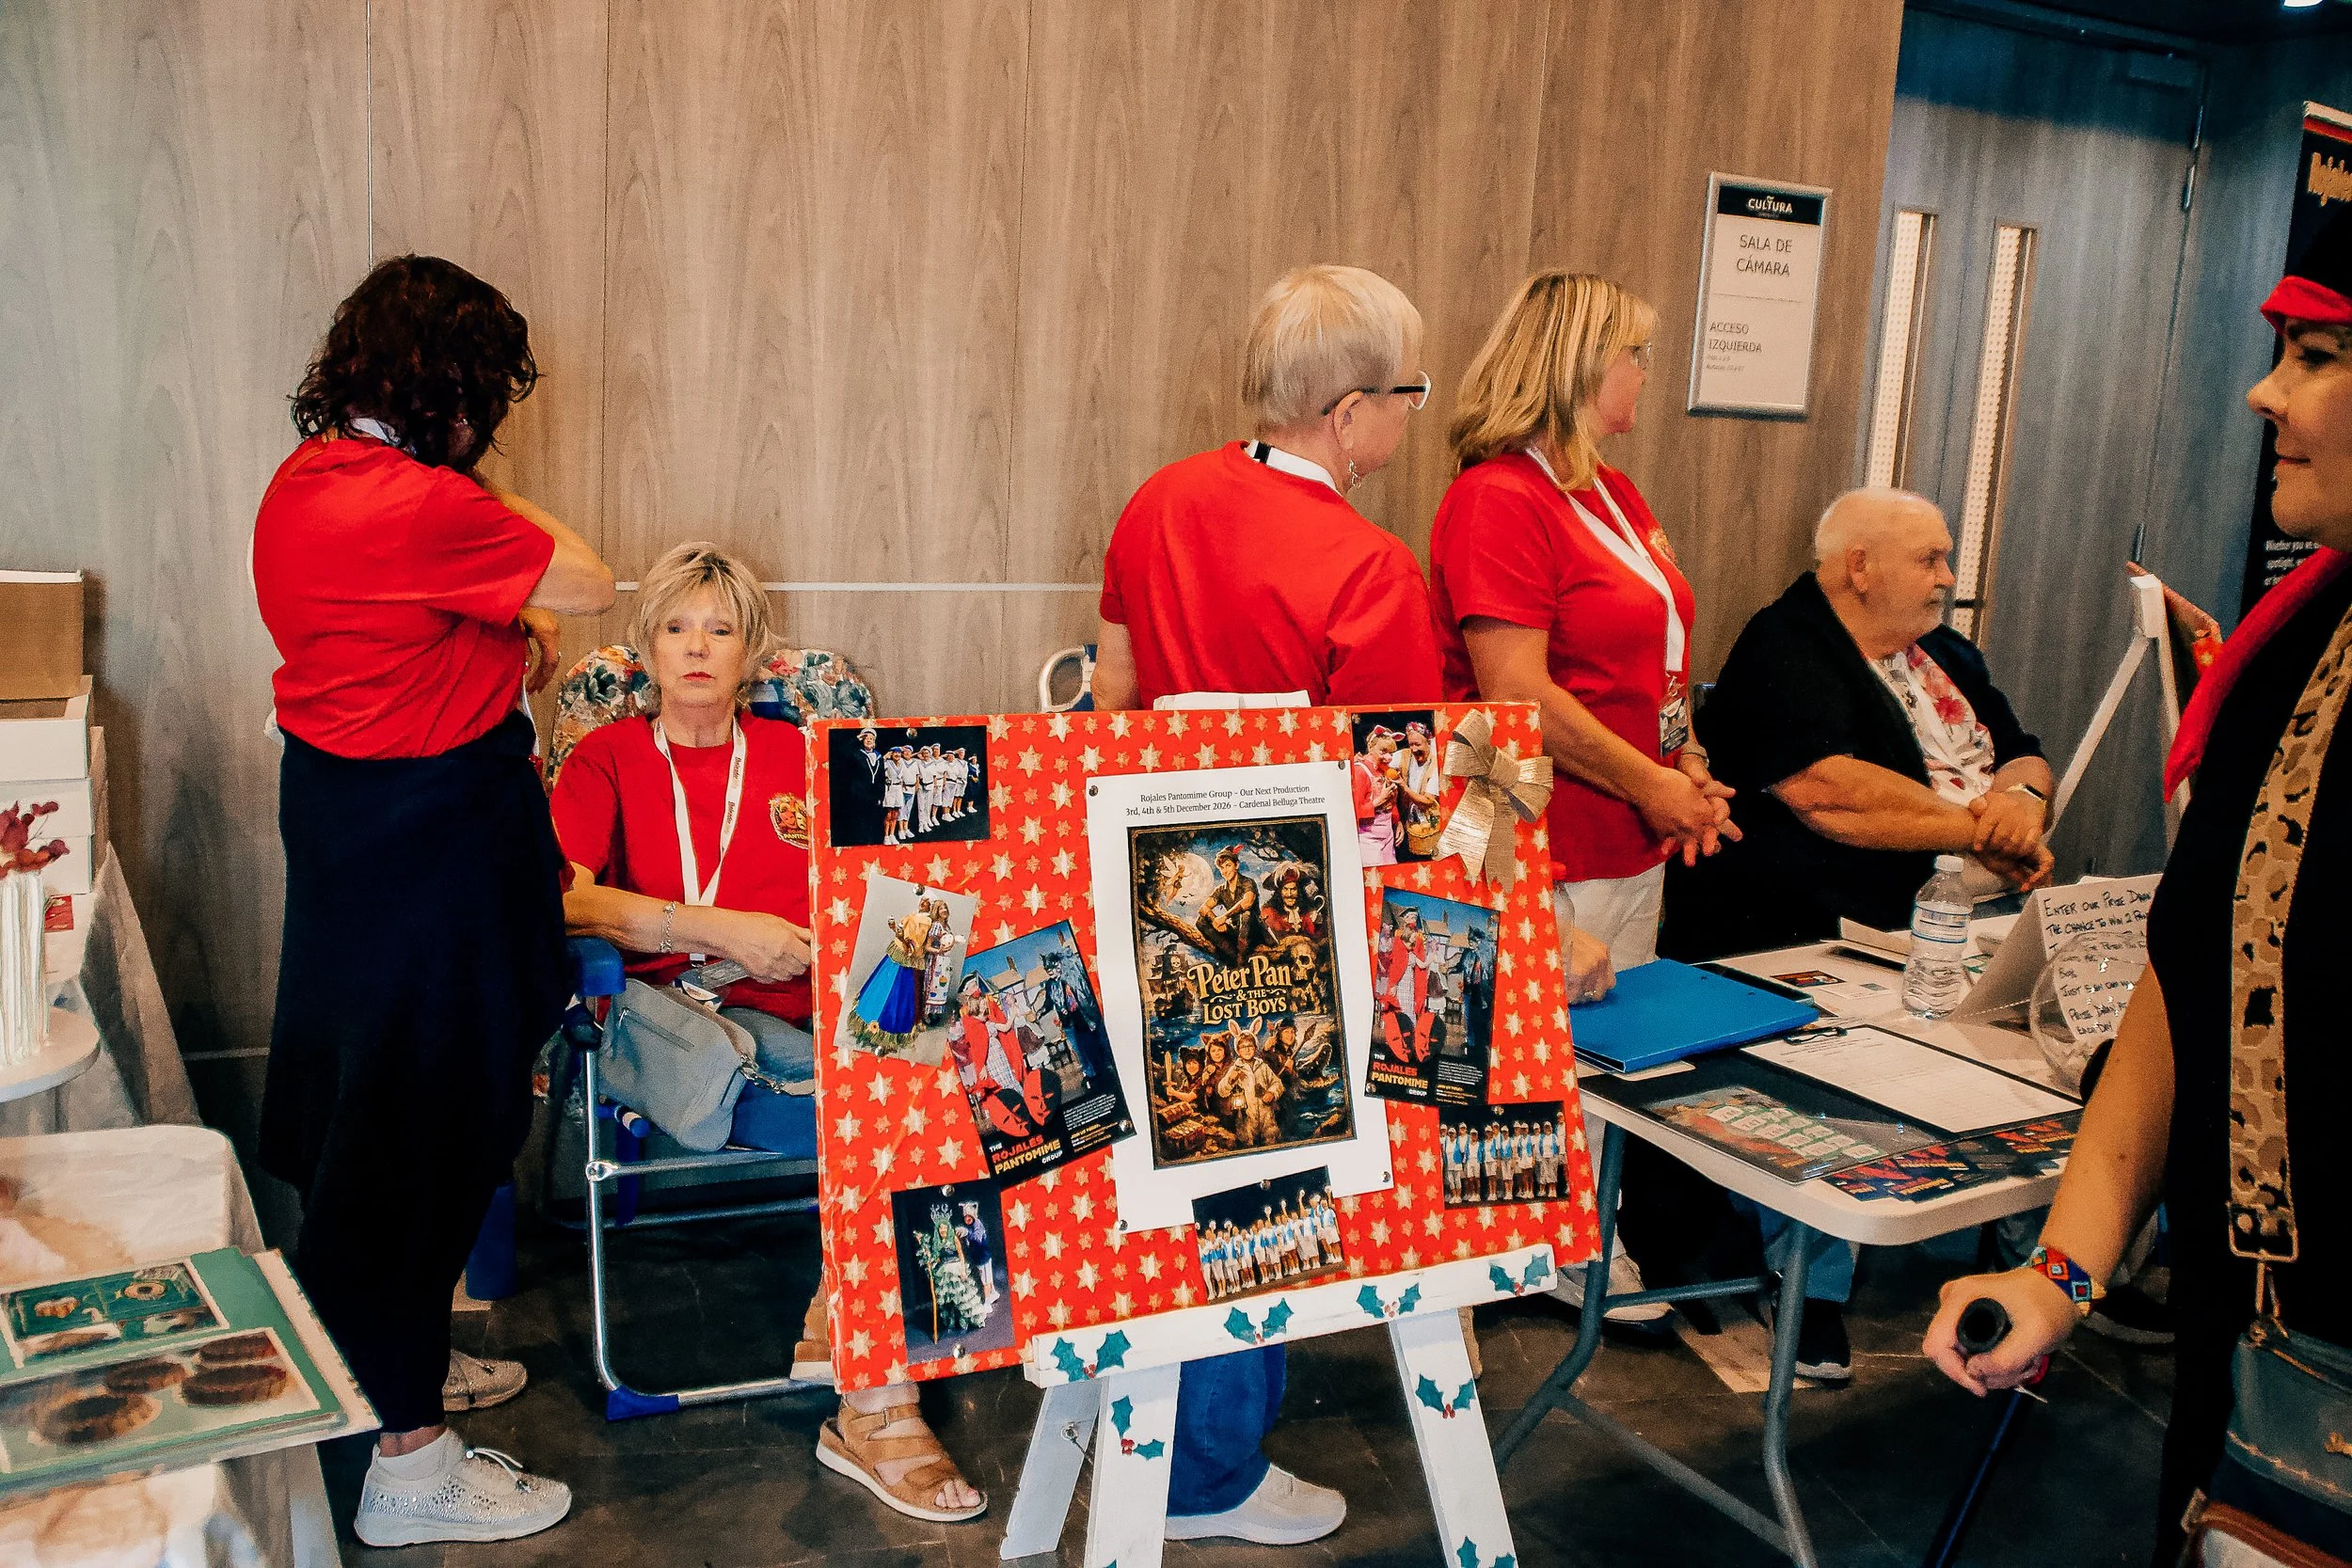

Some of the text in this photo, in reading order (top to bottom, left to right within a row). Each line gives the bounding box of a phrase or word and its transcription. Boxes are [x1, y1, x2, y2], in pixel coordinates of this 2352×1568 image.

[1748, 197, 1793, 214] CULTURA
[1740, 234, 1793, 253] SALA DE
[1736, 255, 1790, 277] CÁMARA
[1709, 322, 1750, 335] ACCESO
[1708, 339, 1762, 354] IZQUIERDA
[1140, 793, 1167, 803] Rojales
[1168, 791, 1208, 801] Pantomime
[1208, 790, 1232, 799] Group
[1239, 788, 1253, 797] Our
[1255, 787, 1272, 796] Next
[1273, 784, 1310, 795] Production
[1126, 807, 1140, 816] 3rd,
[1141, 806, 1154, 815] 4th
[1163, 805, 1175, 814] 5th
[1176, 803, 1211, 813] December
[1212, 801, 1232, 811] 2026
[1239, 799, 1271, 809] Cardenal
[1298, 796, 1326, 804] Theatre
[2043, 897, 2078, 916] ENTER
[2082, 901, 2100, 911] OUR
[2064, 921, 2095, 934] CHANCE
[2095, 917, 2106, 927] TO
[2124, 912, 2133, 923] 2
[1186, 955, 1293, 1000] Peter Pan
[1236, 989, 1267, 1002] & THE
[1202, 997, 1287, 1024] LOST BOYS
[1373, 1061, 1418, 1077] ROJALES
[1371, 1071, 1428, 1089] PANTOMIME
[989, 1142, 1003, 1153] THE
[992, 1134, 1044, 1164] ROJALES
[993, 1138, 1061, 1175] PANTOMIME
[1041, 1149, 1063, 1164] GROUP
